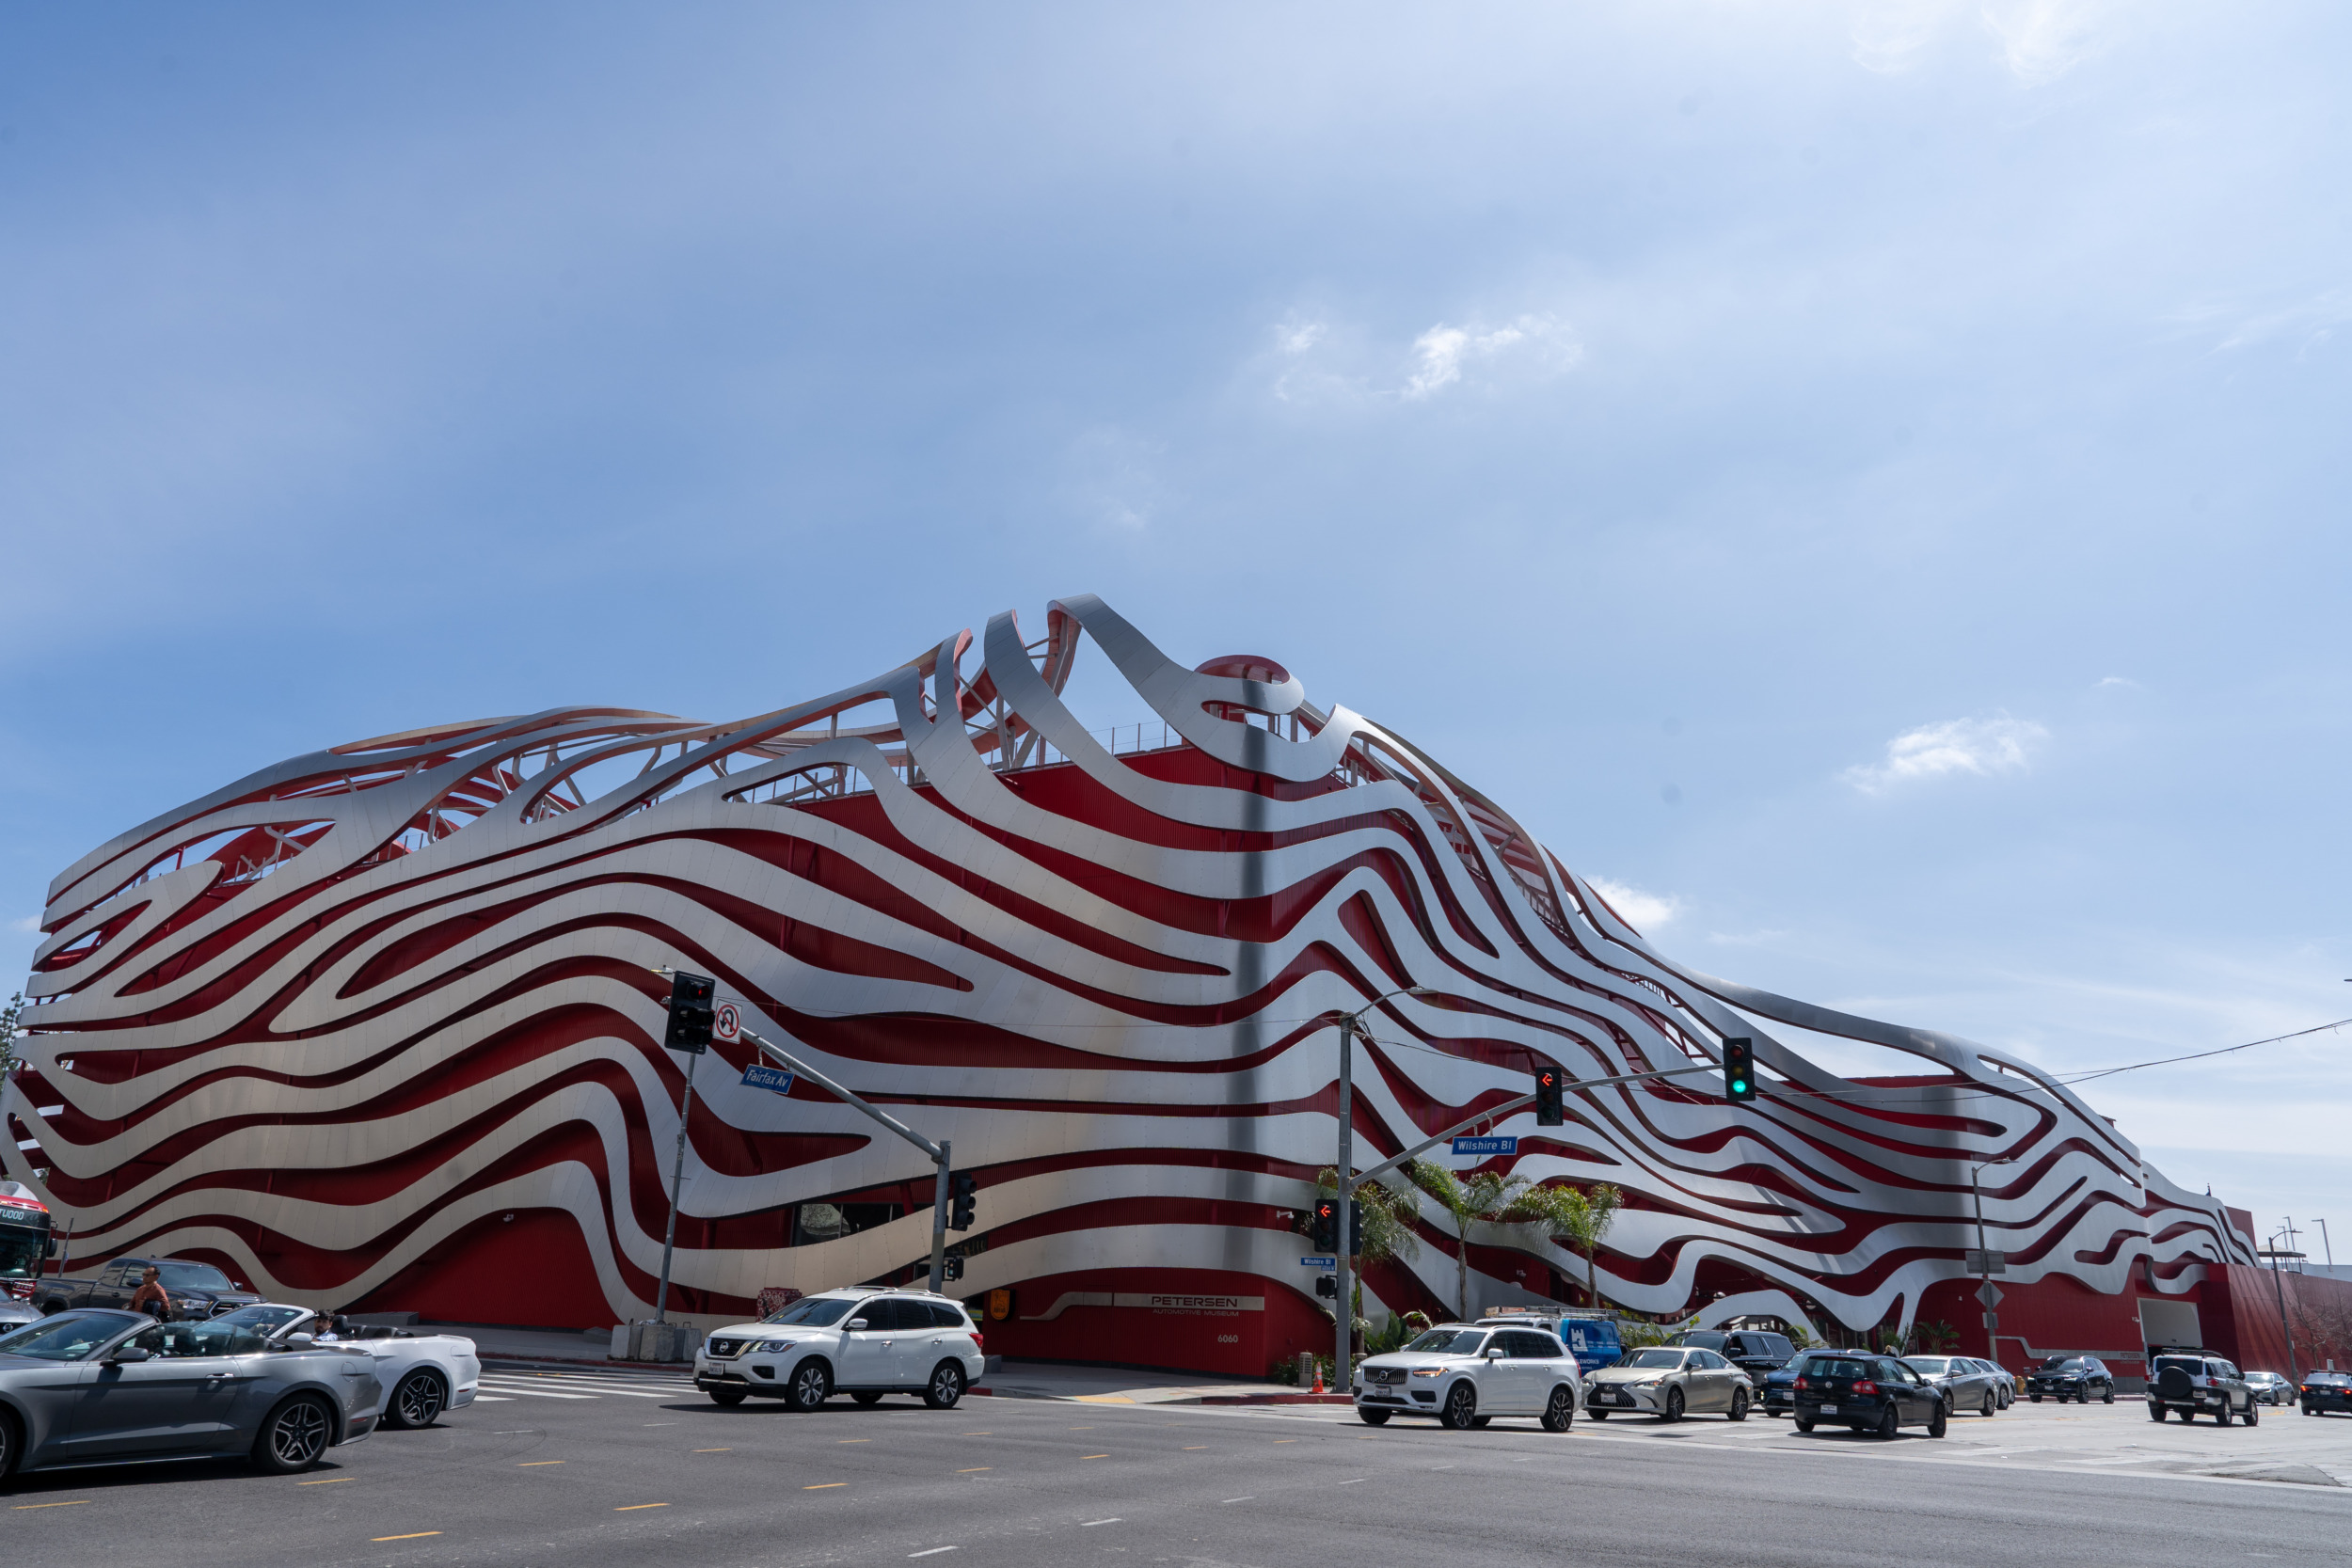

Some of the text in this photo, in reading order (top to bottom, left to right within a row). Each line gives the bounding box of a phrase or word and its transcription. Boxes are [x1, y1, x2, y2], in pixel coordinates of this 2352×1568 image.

[746, 1069, 788, 1087] Fairfax Av
[1458, 1140, 1512, 1150] Wilshire Bl
[1152, 1296, 1238, 1307] PETERSEN
[1217, 1335, 1239, 1343] 6060
